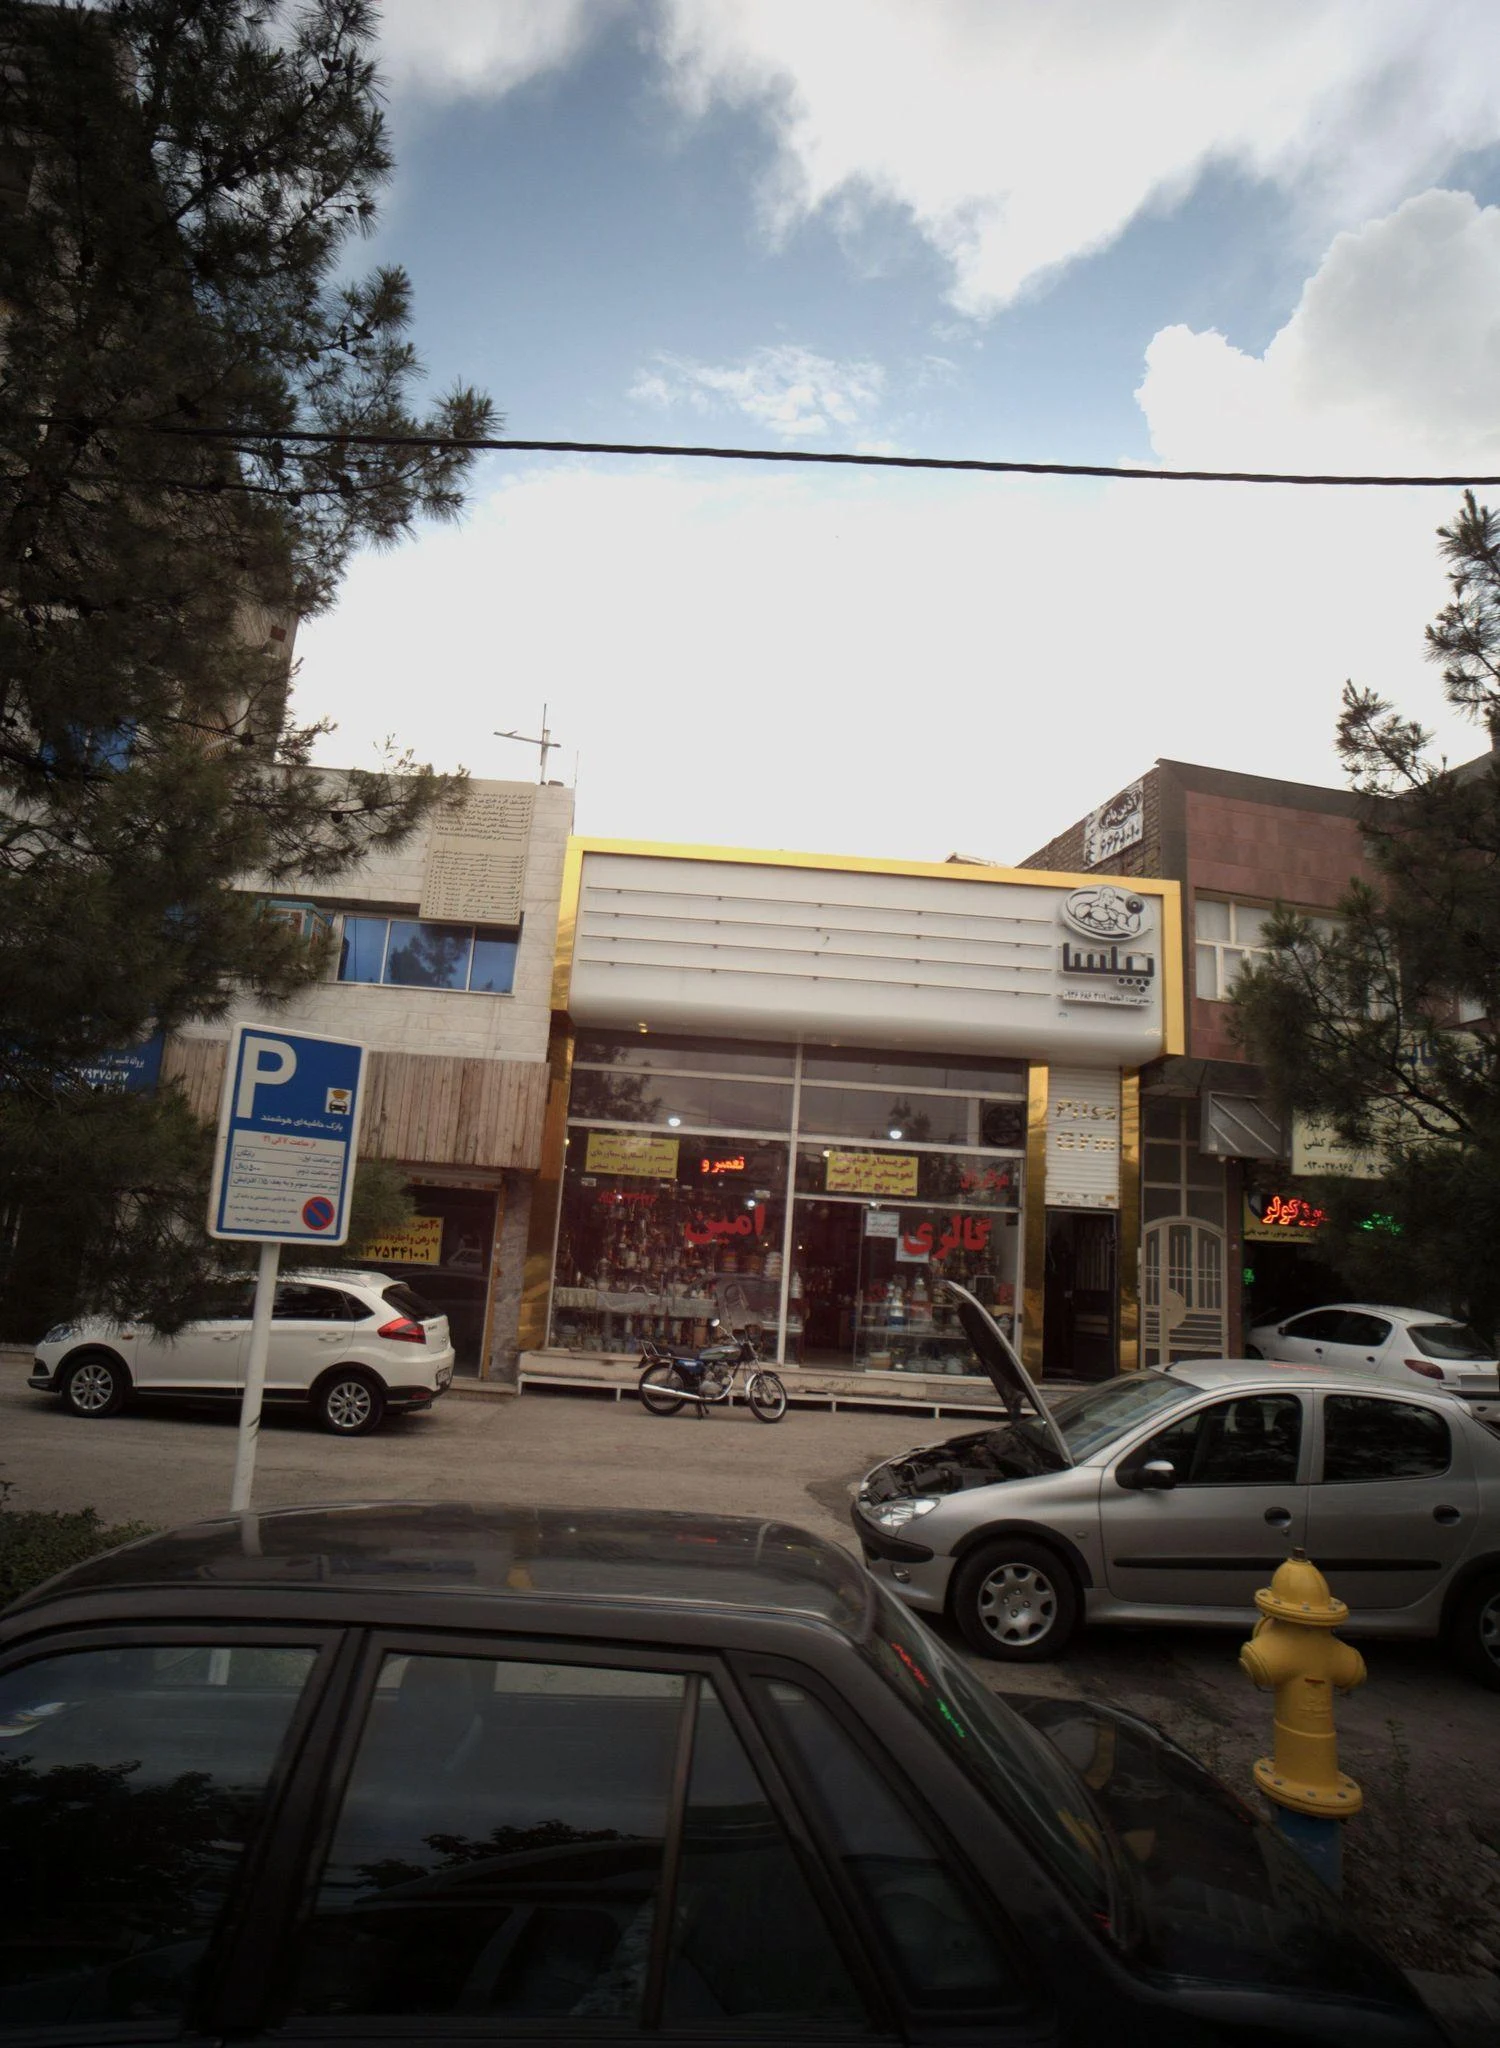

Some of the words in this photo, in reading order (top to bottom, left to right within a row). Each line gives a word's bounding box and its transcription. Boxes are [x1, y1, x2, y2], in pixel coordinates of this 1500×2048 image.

[236, 1035, 297, 1119] P
[700, 1157, 711, 1174] و
[711, 1155, 746, 1174] تعمیر
[683, 1202, 766, 1245] امین
[903, 1211, 993, 1261] گالری
